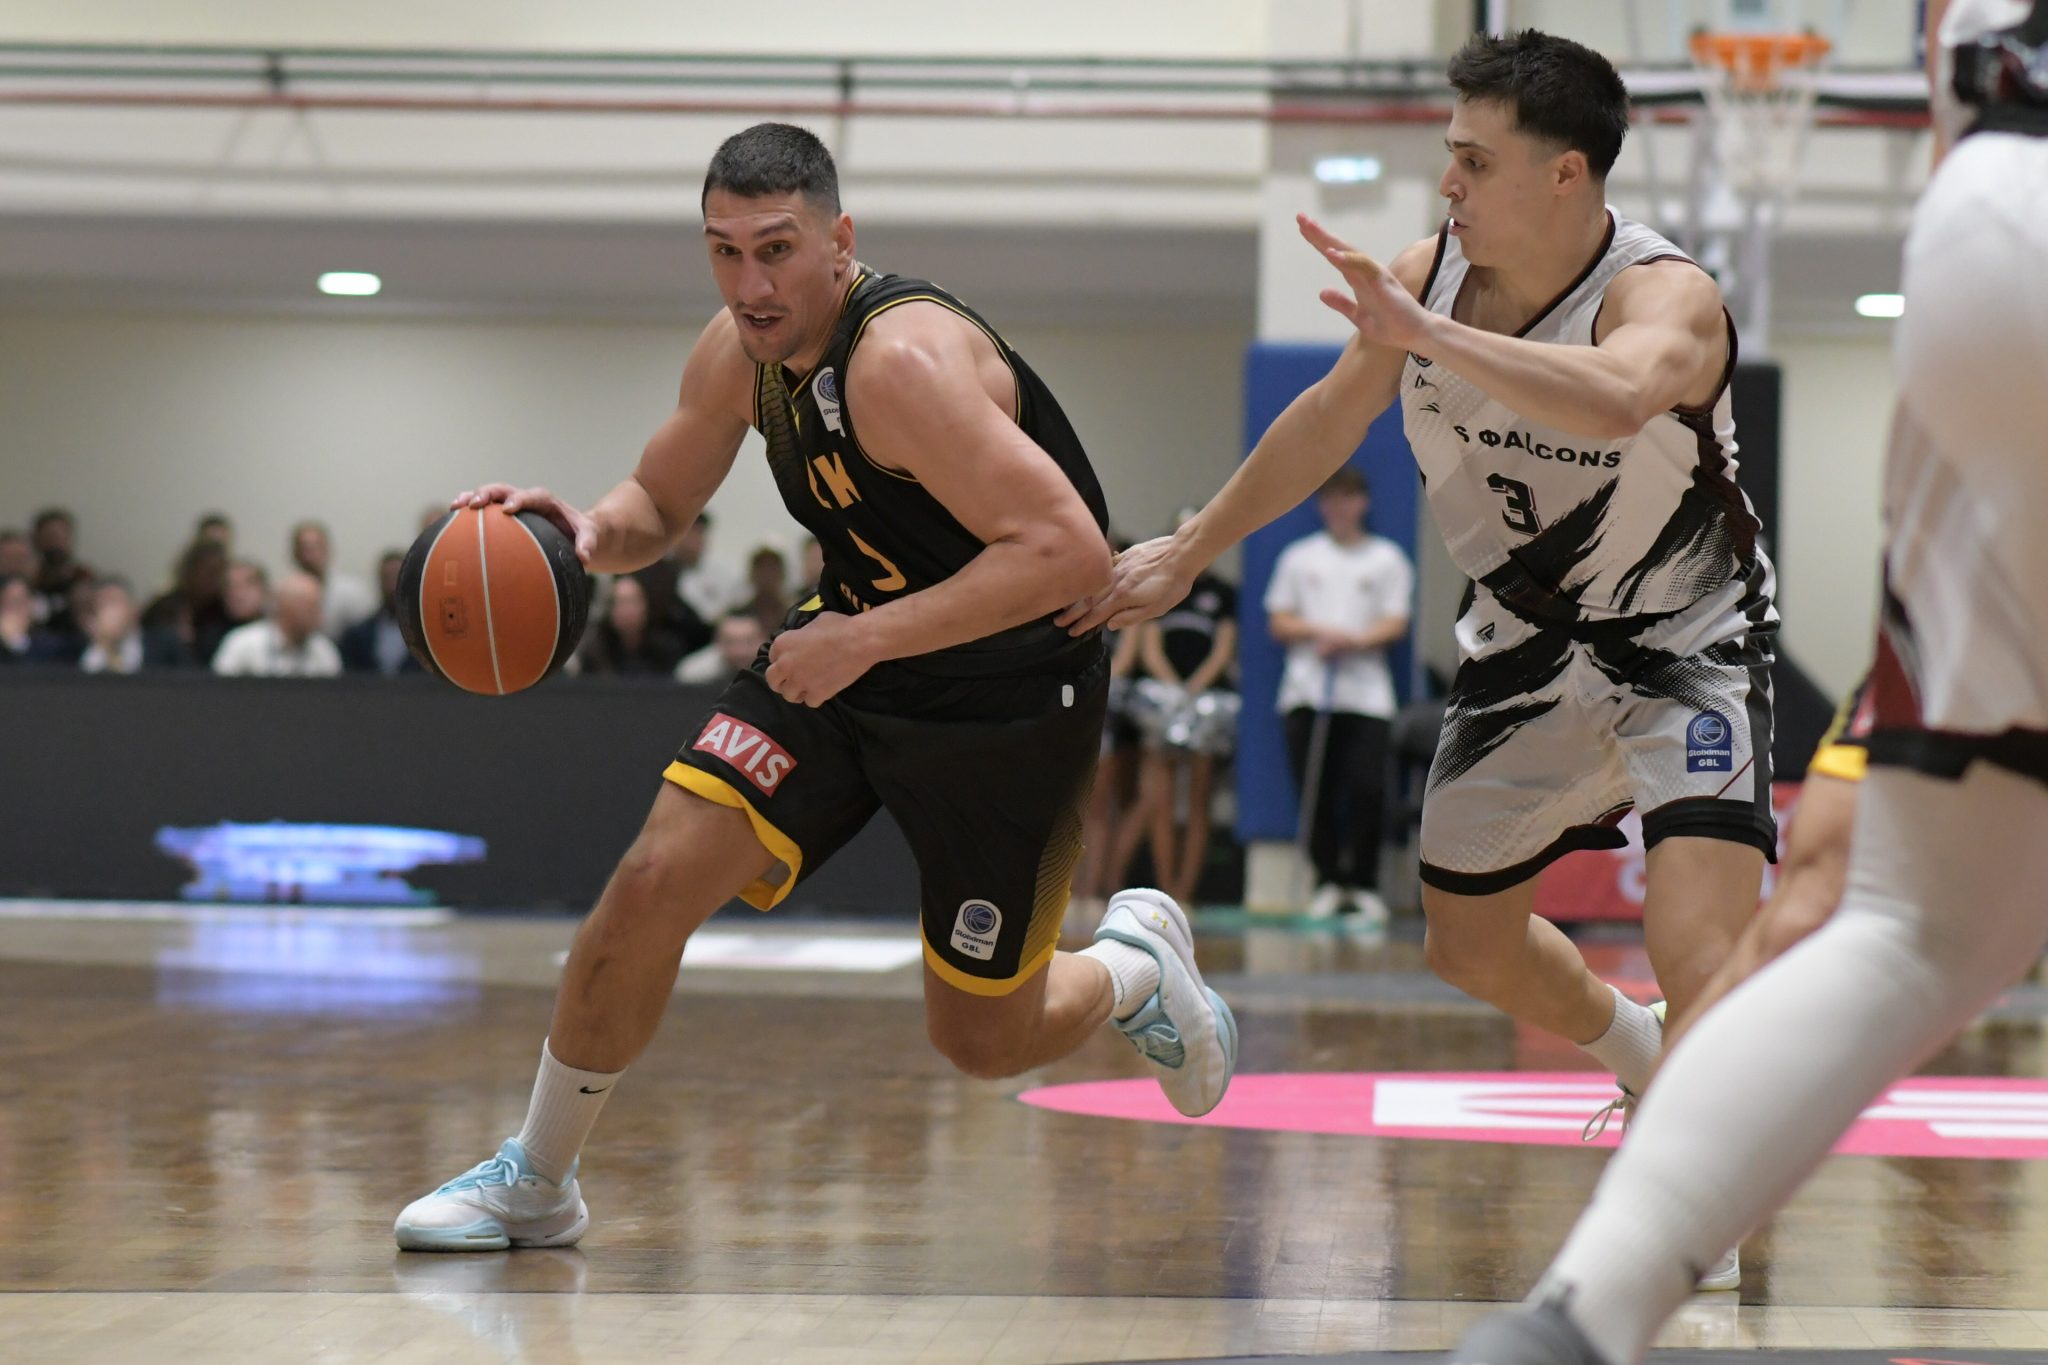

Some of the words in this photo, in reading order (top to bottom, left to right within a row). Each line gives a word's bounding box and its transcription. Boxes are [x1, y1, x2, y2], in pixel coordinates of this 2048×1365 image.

[1486, 473, 1544, 538] 3
[697, 720, 790, 788] AVIS
[1698, 758, 1720, 767] GBL
[961, 942, 981, 954] GBL
